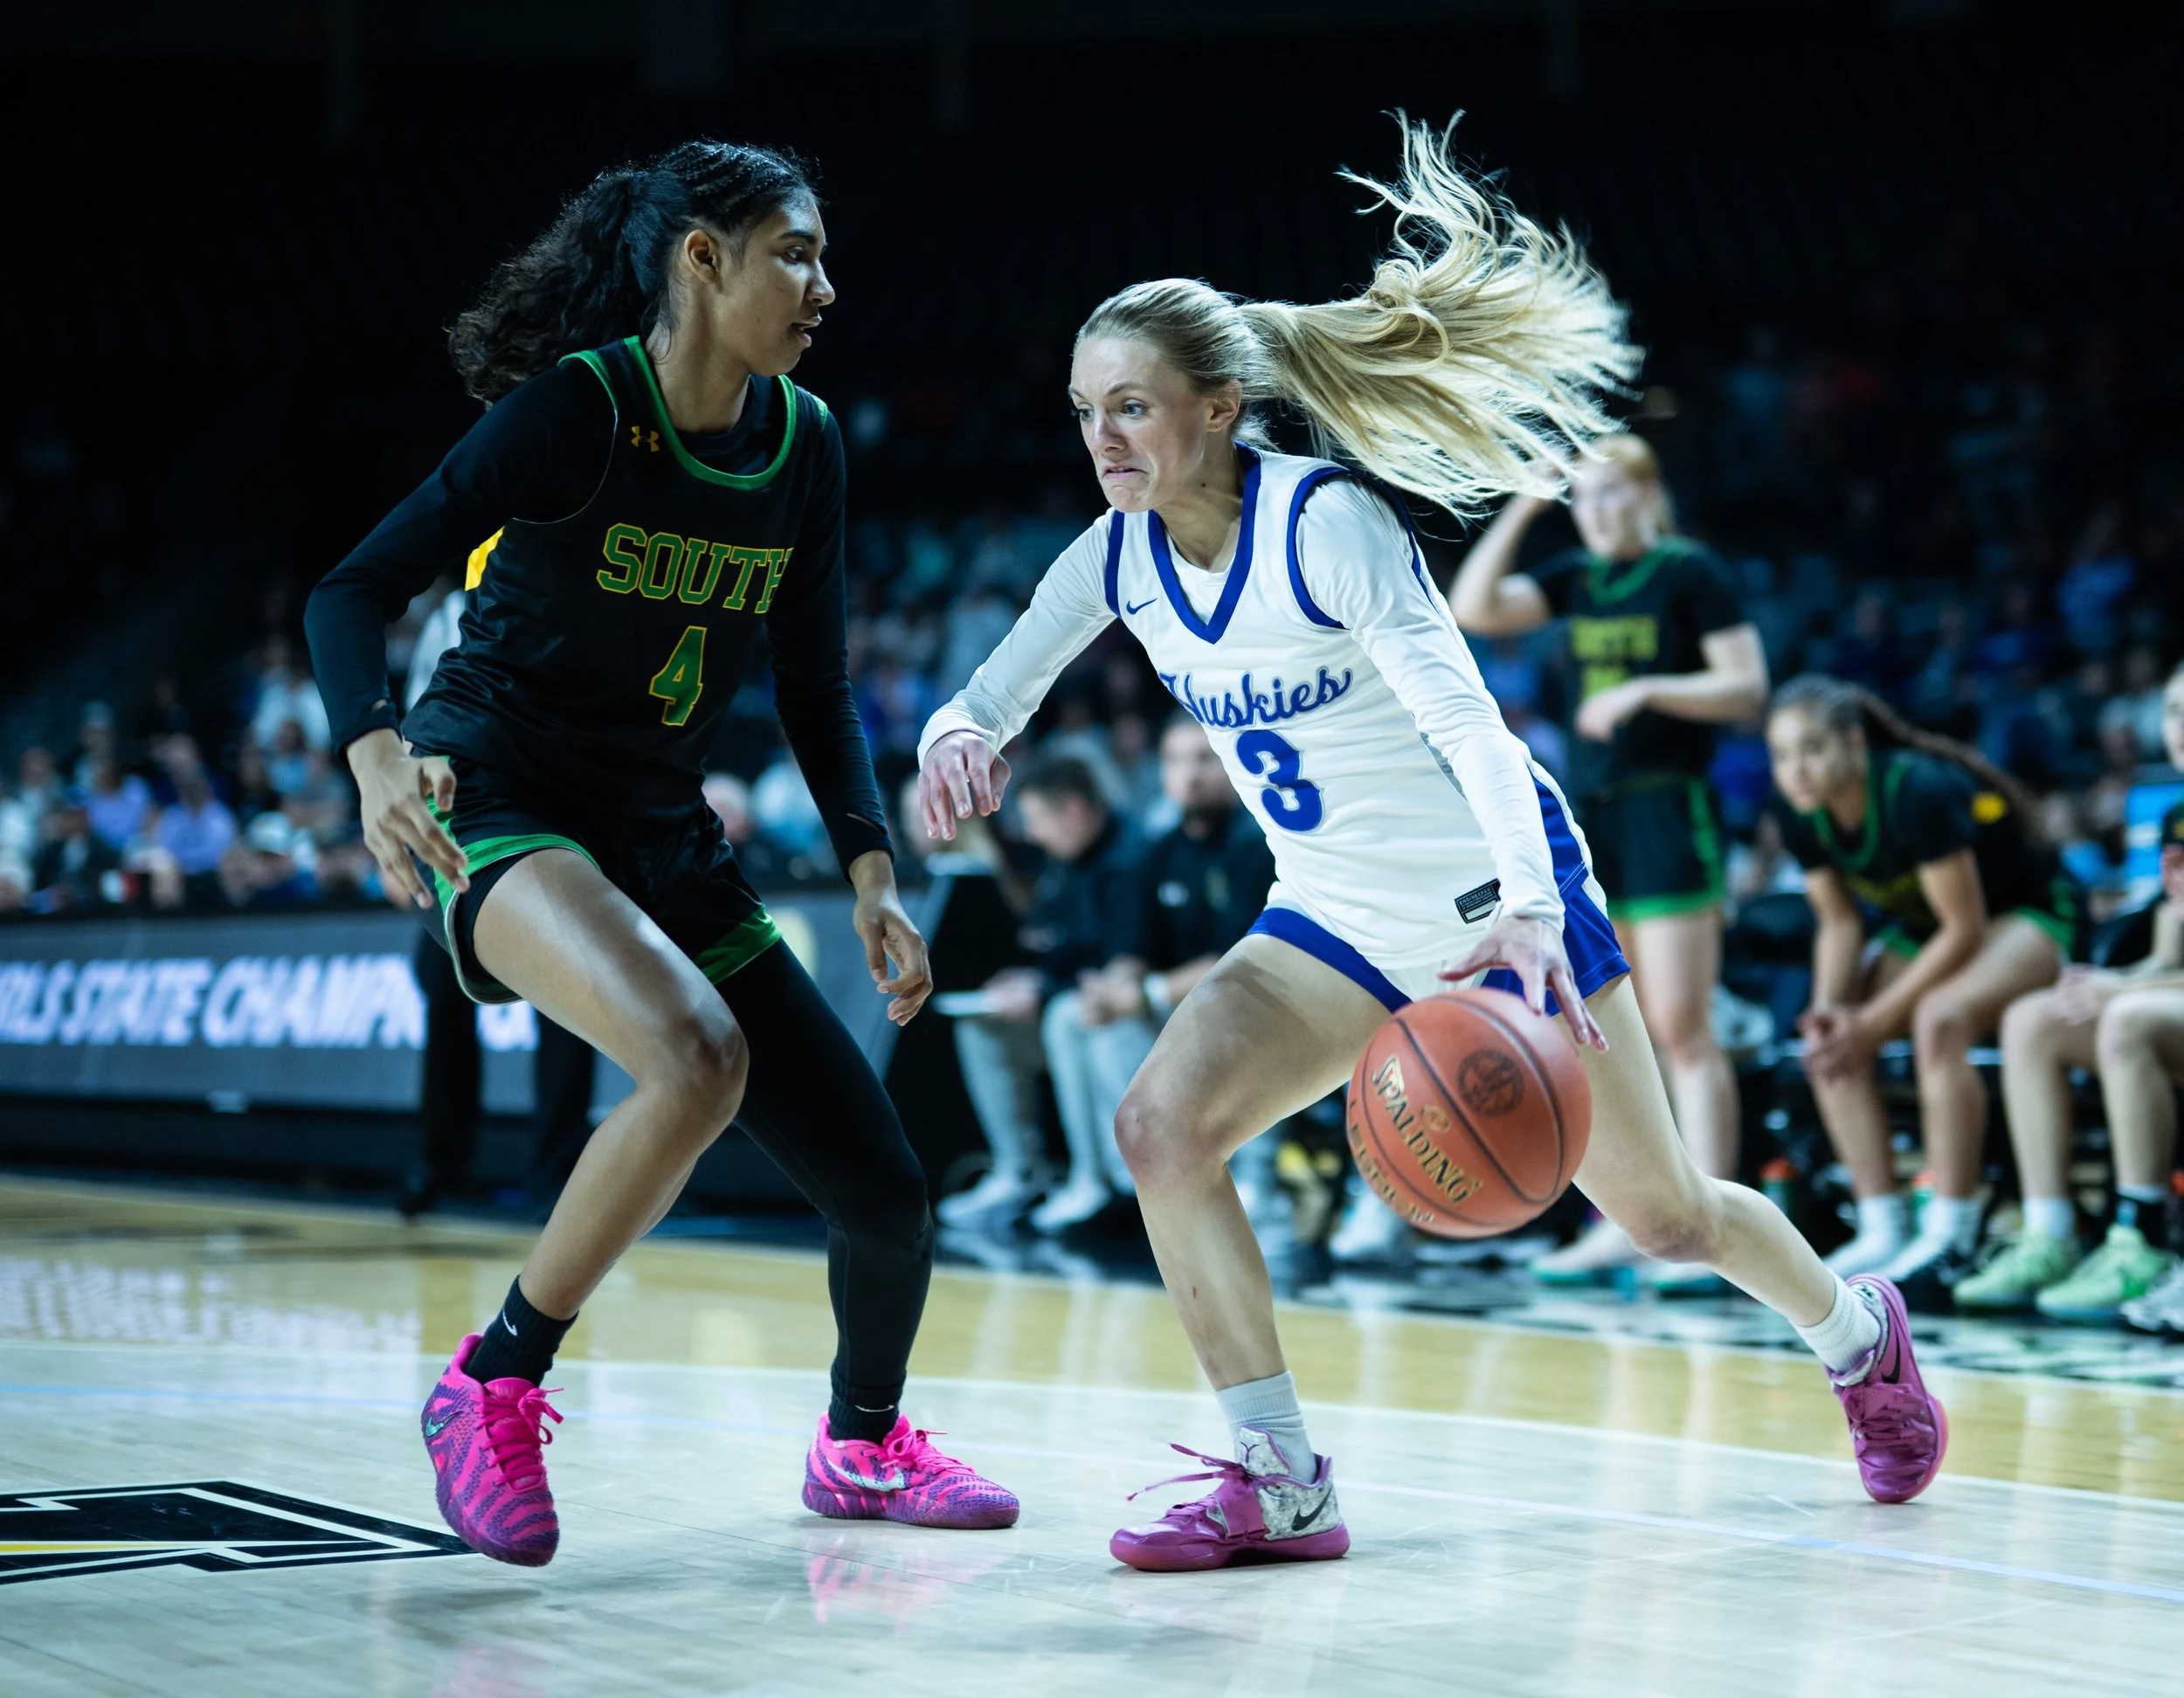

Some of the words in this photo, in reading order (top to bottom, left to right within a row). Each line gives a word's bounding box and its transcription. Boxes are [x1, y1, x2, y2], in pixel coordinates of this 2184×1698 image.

[649, 625, 708, 727] 4
[1158, 666, 1353, 729] Huskies
[1235, 728, 1325, 832] 3
[60, 958, 211, 1046] STATE
[1371, 1053, 1483, 1205] SPALDING
